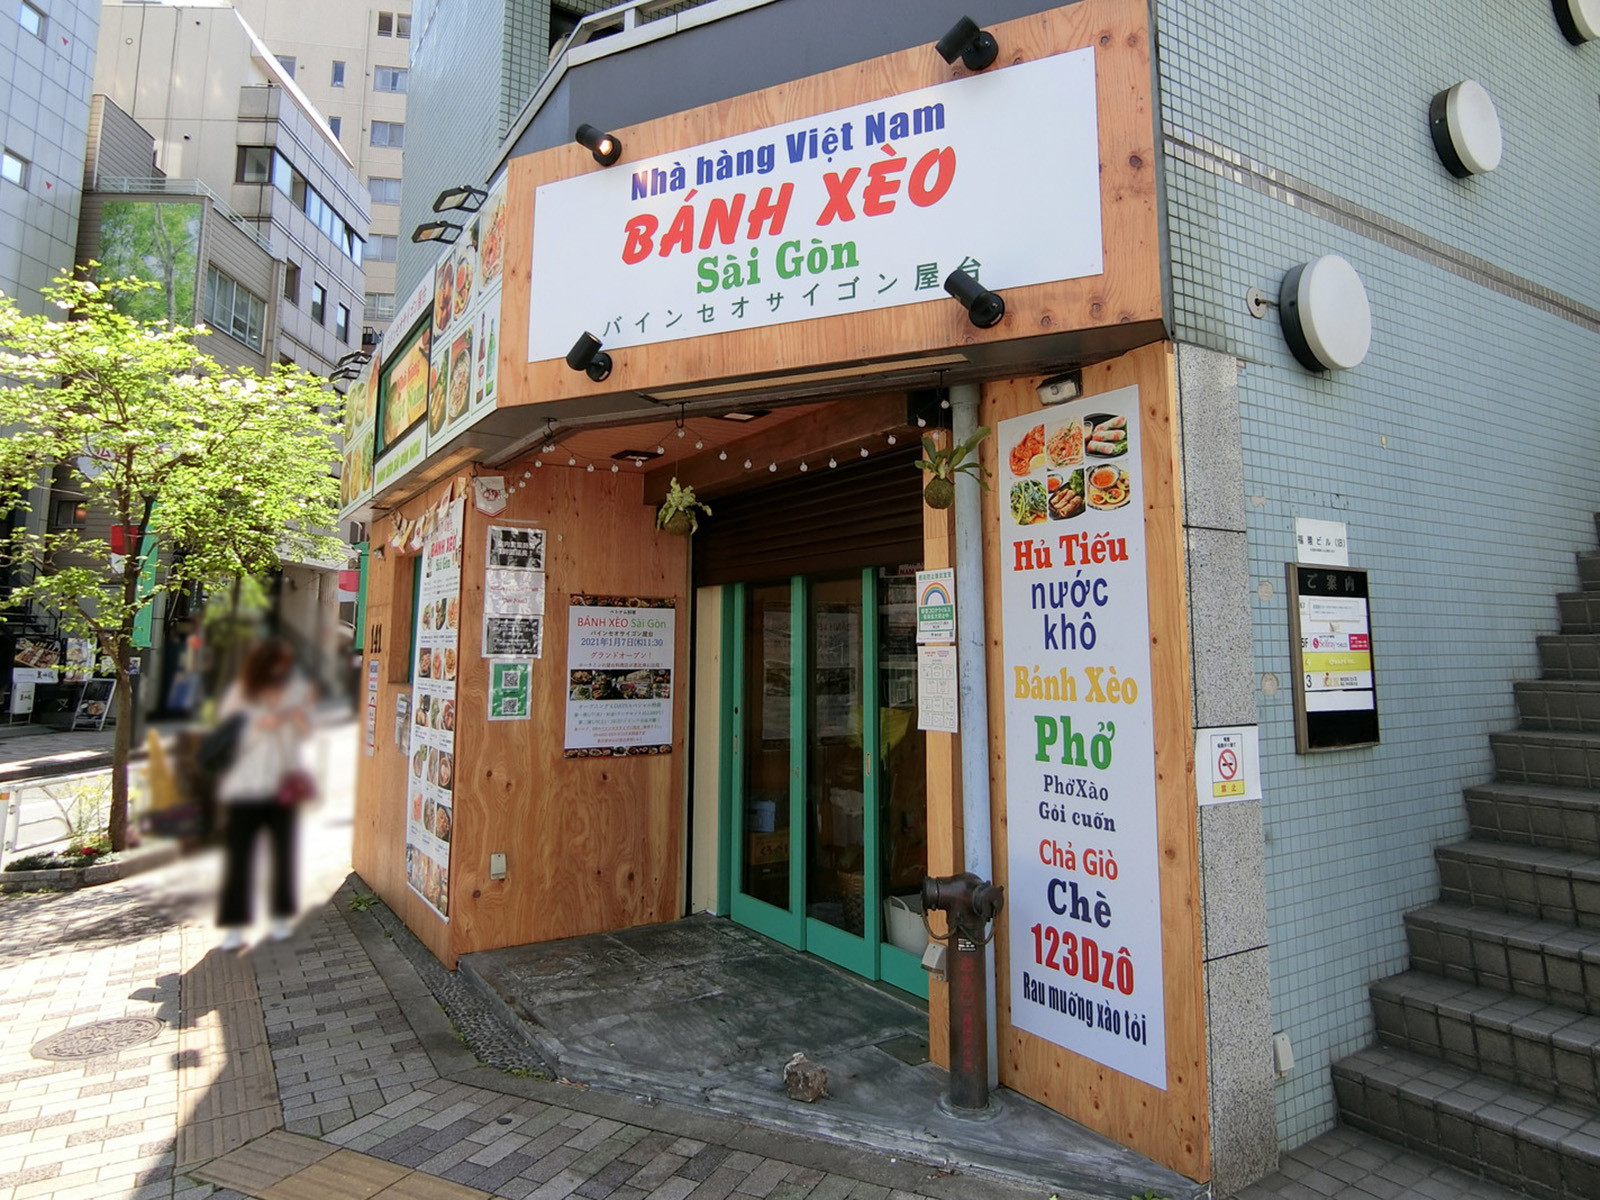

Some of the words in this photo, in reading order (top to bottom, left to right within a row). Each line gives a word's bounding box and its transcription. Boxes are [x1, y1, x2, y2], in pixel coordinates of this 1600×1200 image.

[631, 161, 686, 201] Nhà
[695, 144, 775, 186] hàng
[785, 121, 853, 164] Việt
[865, 102, 945, 147] Nam
[622, 182, 795, 265] BÁNH
[816, 143, 957, 226] XÈO
[697, 247, 761, 294] Sài
[775, 238, 860, 279] Gòn
[1013, 539, 1053, 571] Hủ
[1059, 531, 1129, 566] Tiếu
[1031, 569, 1109, 610] nước
[577, 615, 606, 627] BÁNH
[608, 616, 629, 628] XÈO
[1044, 611, 1097, 650] khô
[1013, 665, 1078, 702] Bánh
[1084, 665, 1138, 705] Xèo
[1034, 715, 1116, 770] Phở
[1038, 801, 1067, 823] Gỏi
[1072, 812, 1116, 832] cuốn
[1039, 839, 1076, 871] Chả
[1082, 848, 1119, 881] Giò
[1047, 878, 1112, 929] Chè
[1030, 923, 1135, 996] 123Dzô
[1023, 971, 1045, 1006] Rau
[1096, 1000, 1121, 1036] xào
[1124, 1010, 1147, 1046] tỏi
